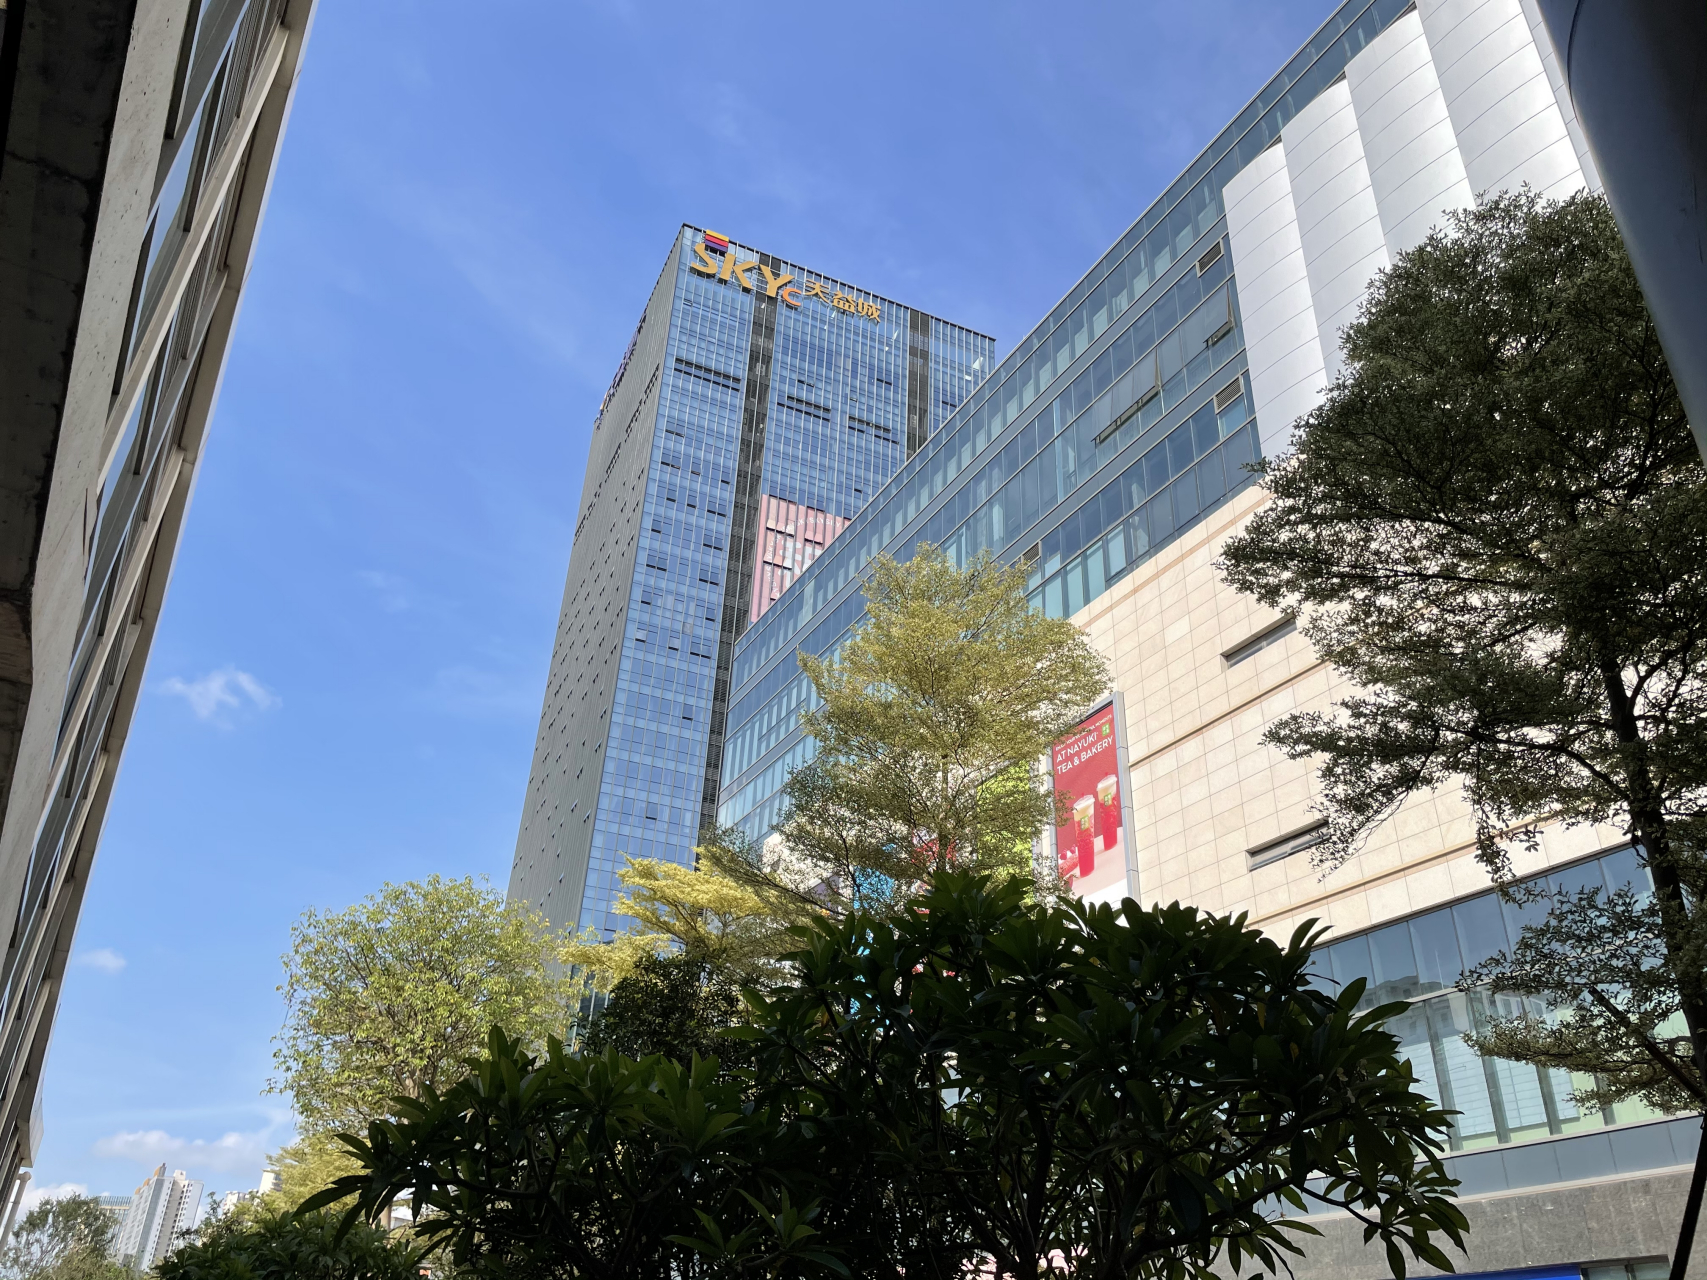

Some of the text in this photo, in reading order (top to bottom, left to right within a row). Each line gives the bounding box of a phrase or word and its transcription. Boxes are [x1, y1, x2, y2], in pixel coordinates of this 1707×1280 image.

[804, 278, 881, 323] 天益城
[1056, 732, 1098, 763] AT NAYUKI
[1057, 735, 1113, 775] TEA & BAKERY
